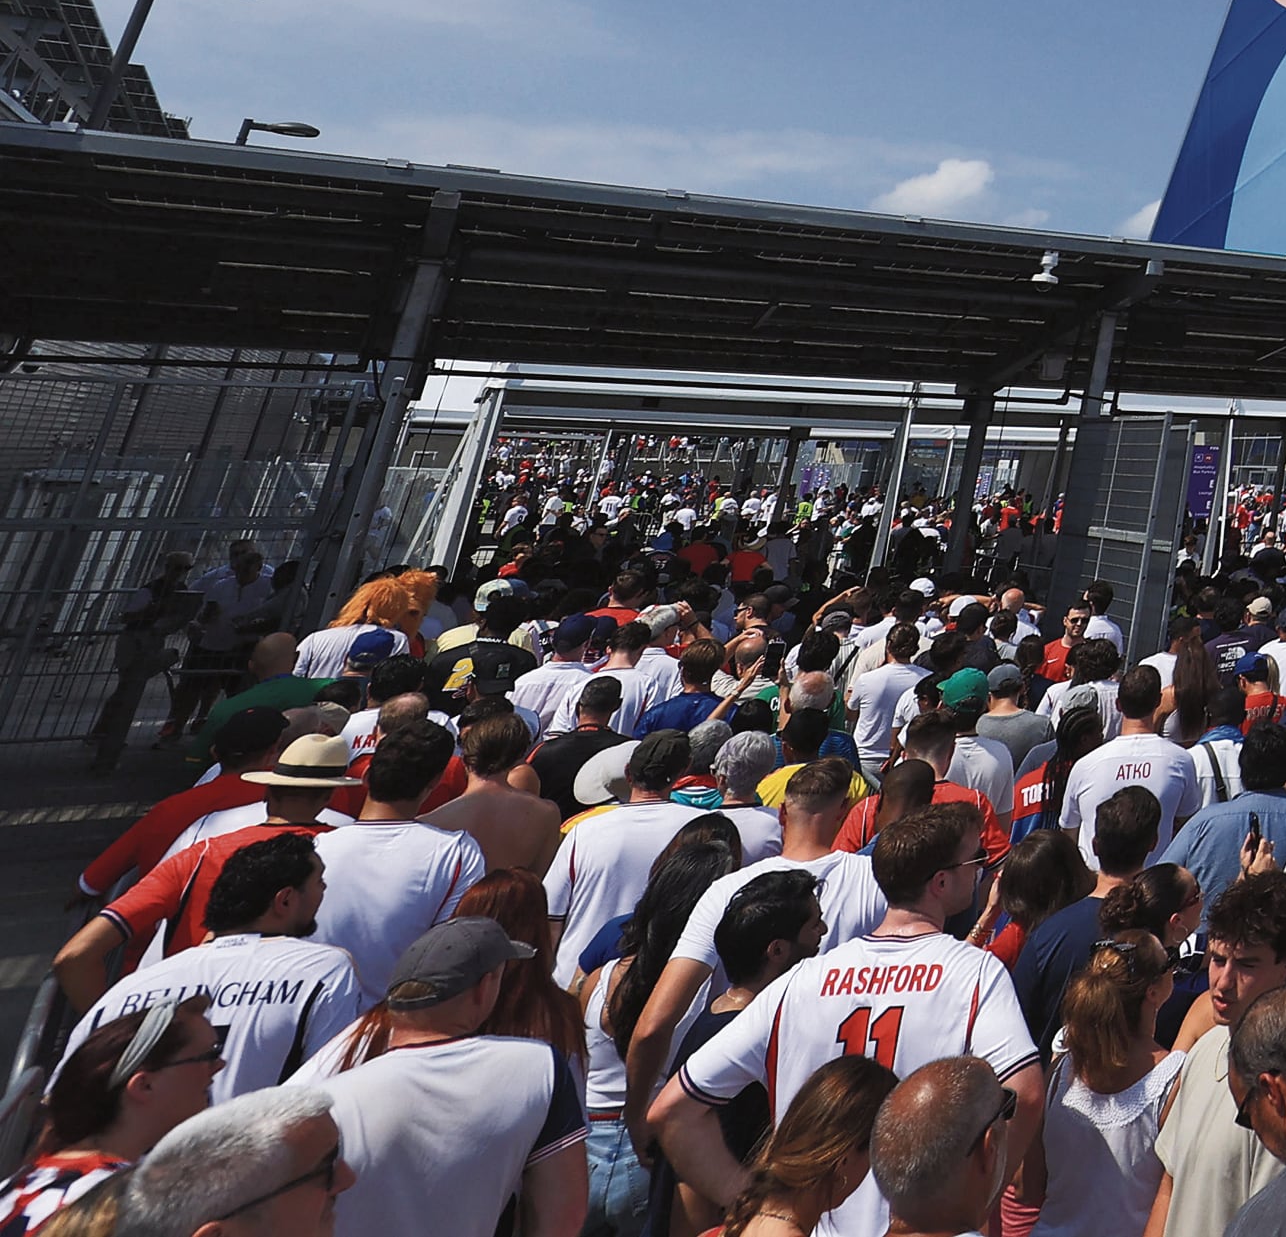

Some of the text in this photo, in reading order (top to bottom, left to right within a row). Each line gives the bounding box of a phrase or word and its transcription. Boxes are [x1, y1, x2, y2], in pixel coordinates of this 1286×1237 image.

[1115, 762, 1151, 781] ATKO
[820, 964, 944, 997] RASHFORD
[836, 1006, 905, 1069] 11
